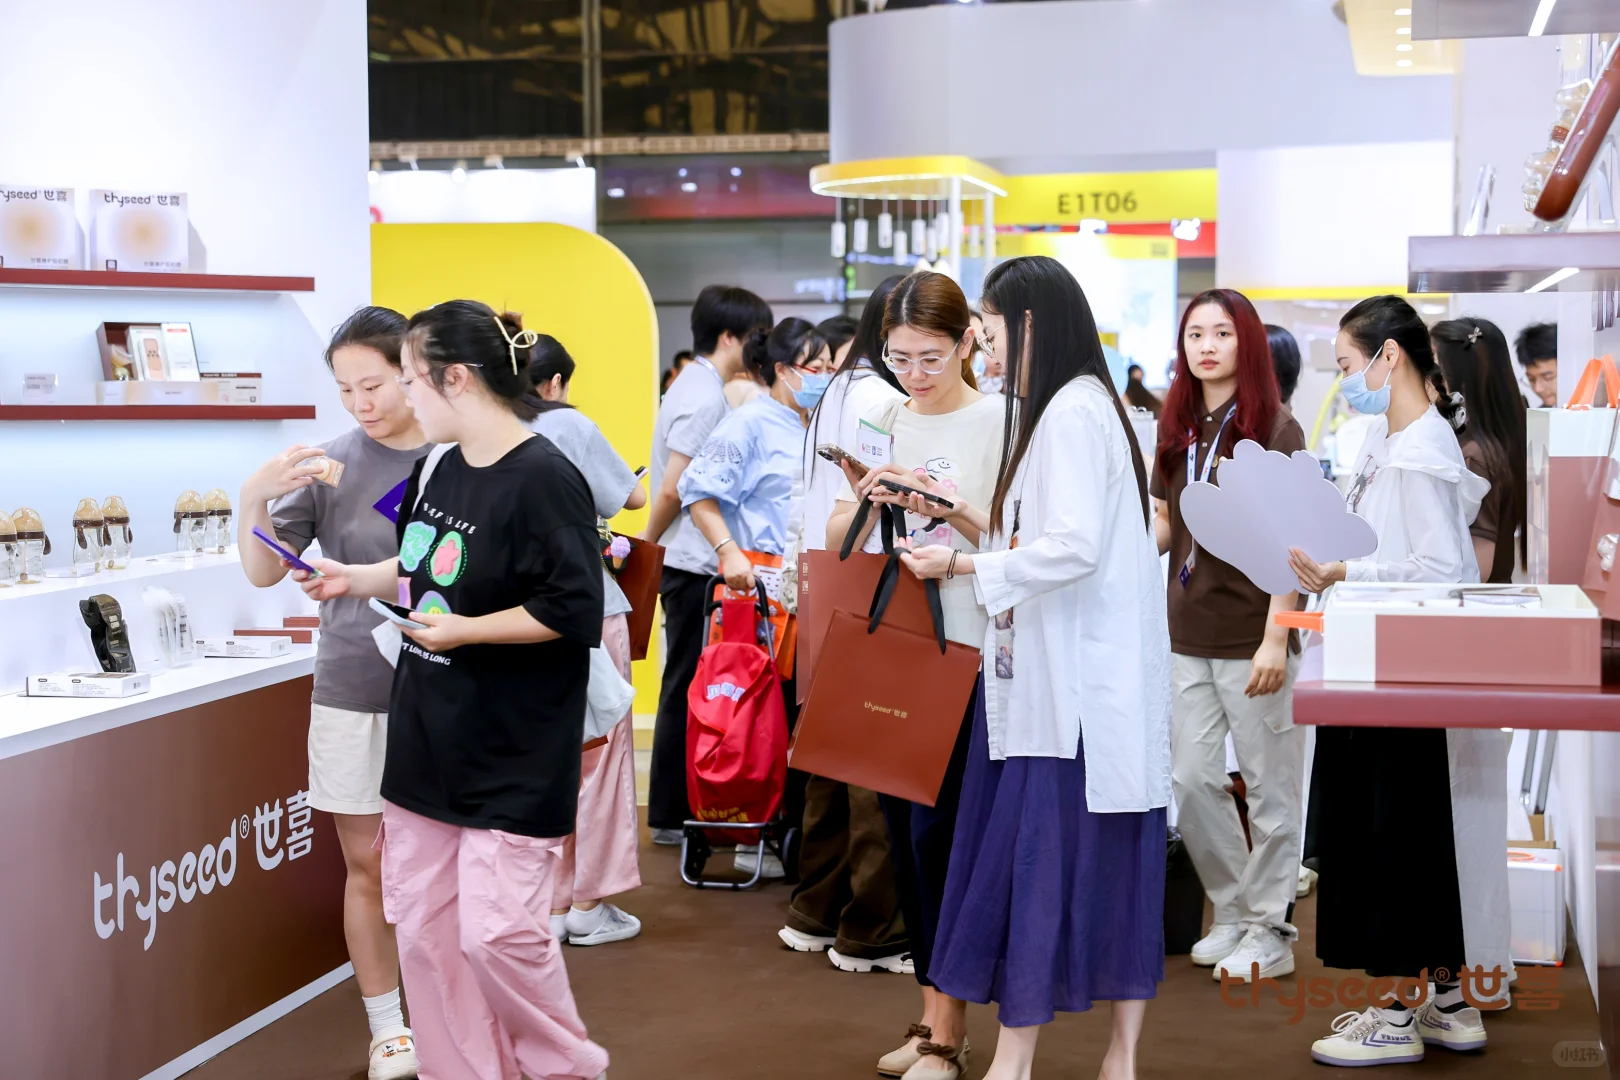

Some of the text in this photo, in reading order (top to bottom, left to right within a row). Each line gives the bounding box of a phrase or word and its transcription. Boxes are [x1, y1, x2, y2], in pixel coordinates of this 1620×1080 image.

[1058, 192, 1138, 214] E1T06
[429, 653, 452, 666] LONG
[253, 789, 314, 871] 世喜
